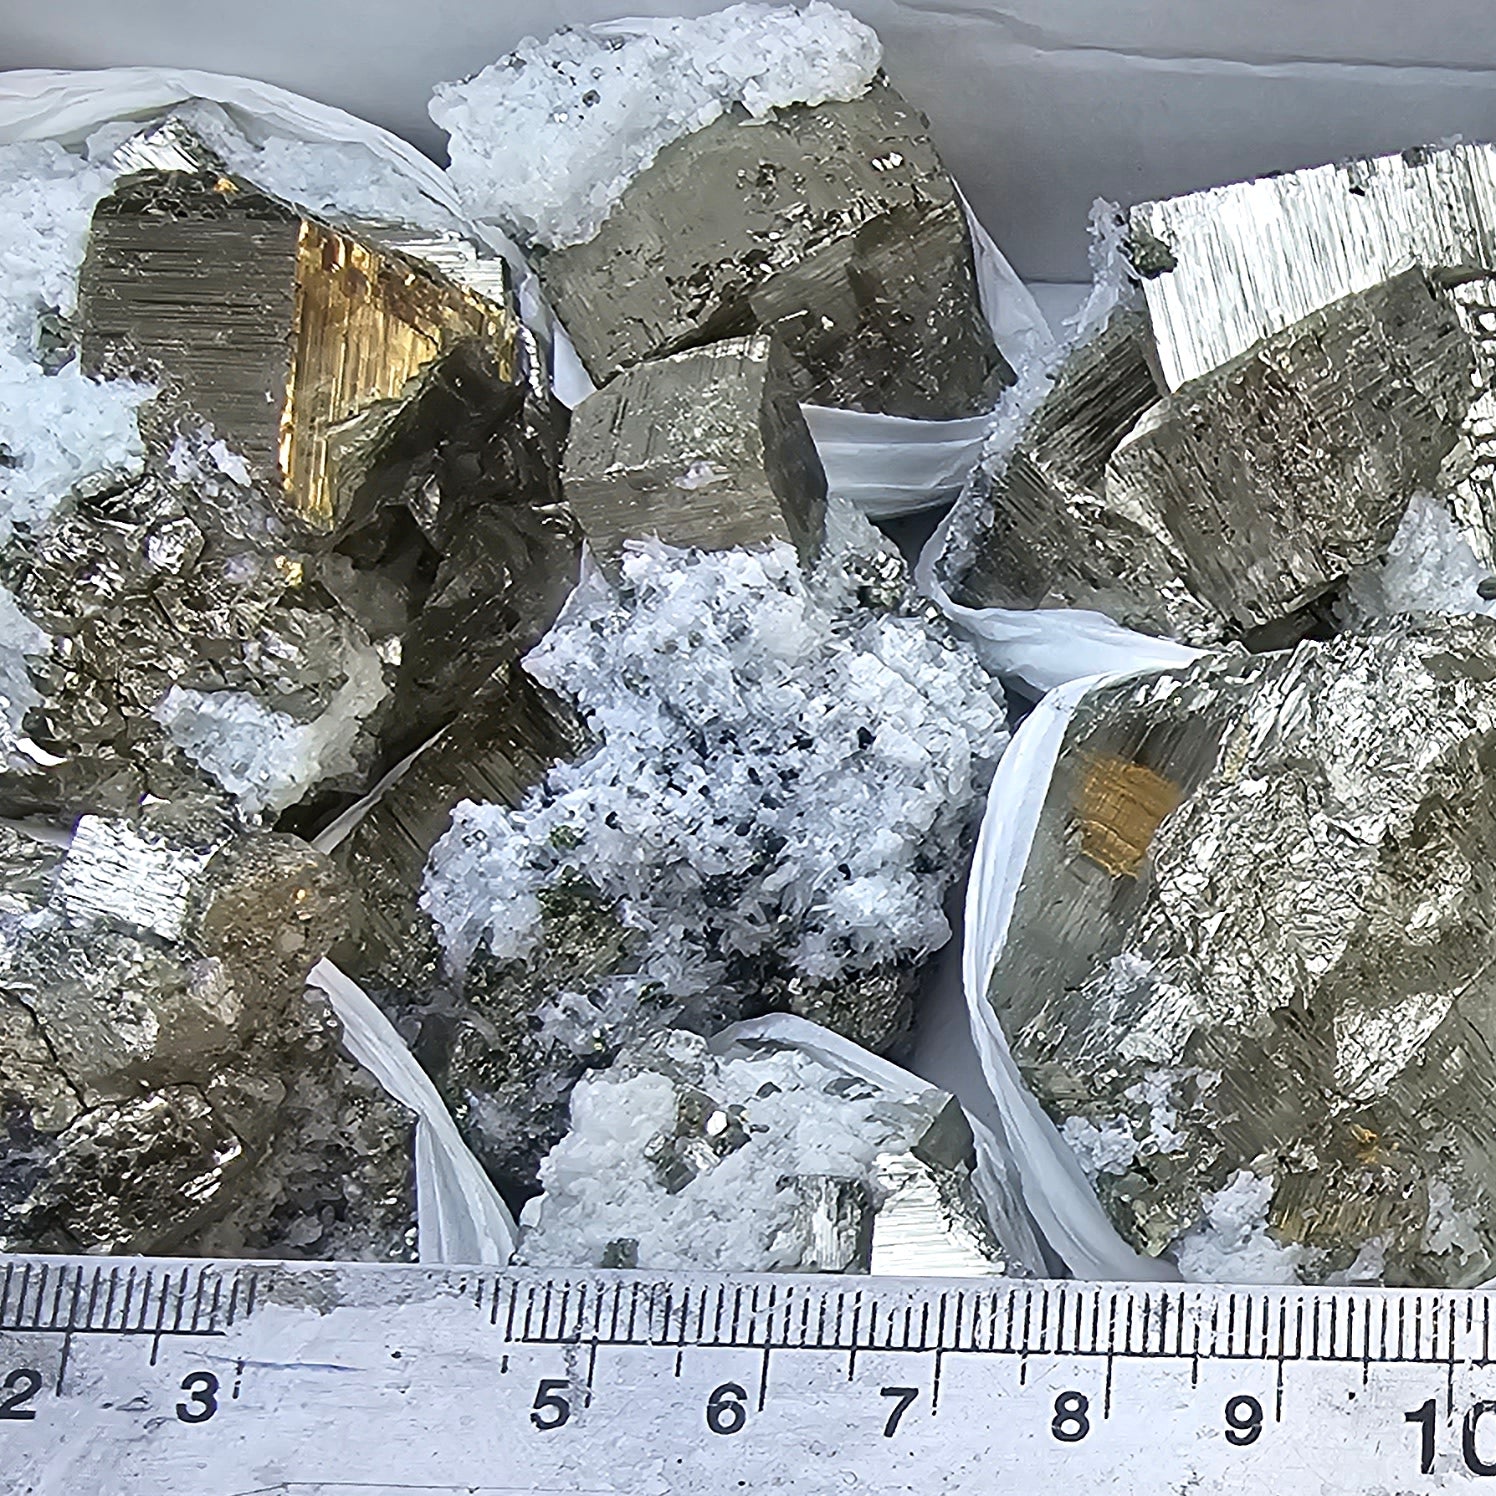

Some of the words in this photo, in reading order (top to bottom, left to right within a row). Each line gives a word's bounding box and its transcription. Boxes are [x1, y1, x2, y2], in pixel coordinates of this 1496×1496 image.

[0, 1368, 42, 1420] 2
[176, 1371, 218, 1423] 3
[530, 1379, 571, 1430] 5
[706, 1383, 748, 1435] 6
[879, 1387, 919, 1438] 7
[1051, 1391, 1090, 1442] 8
[1225, 1395, 1264, 1446] 9
